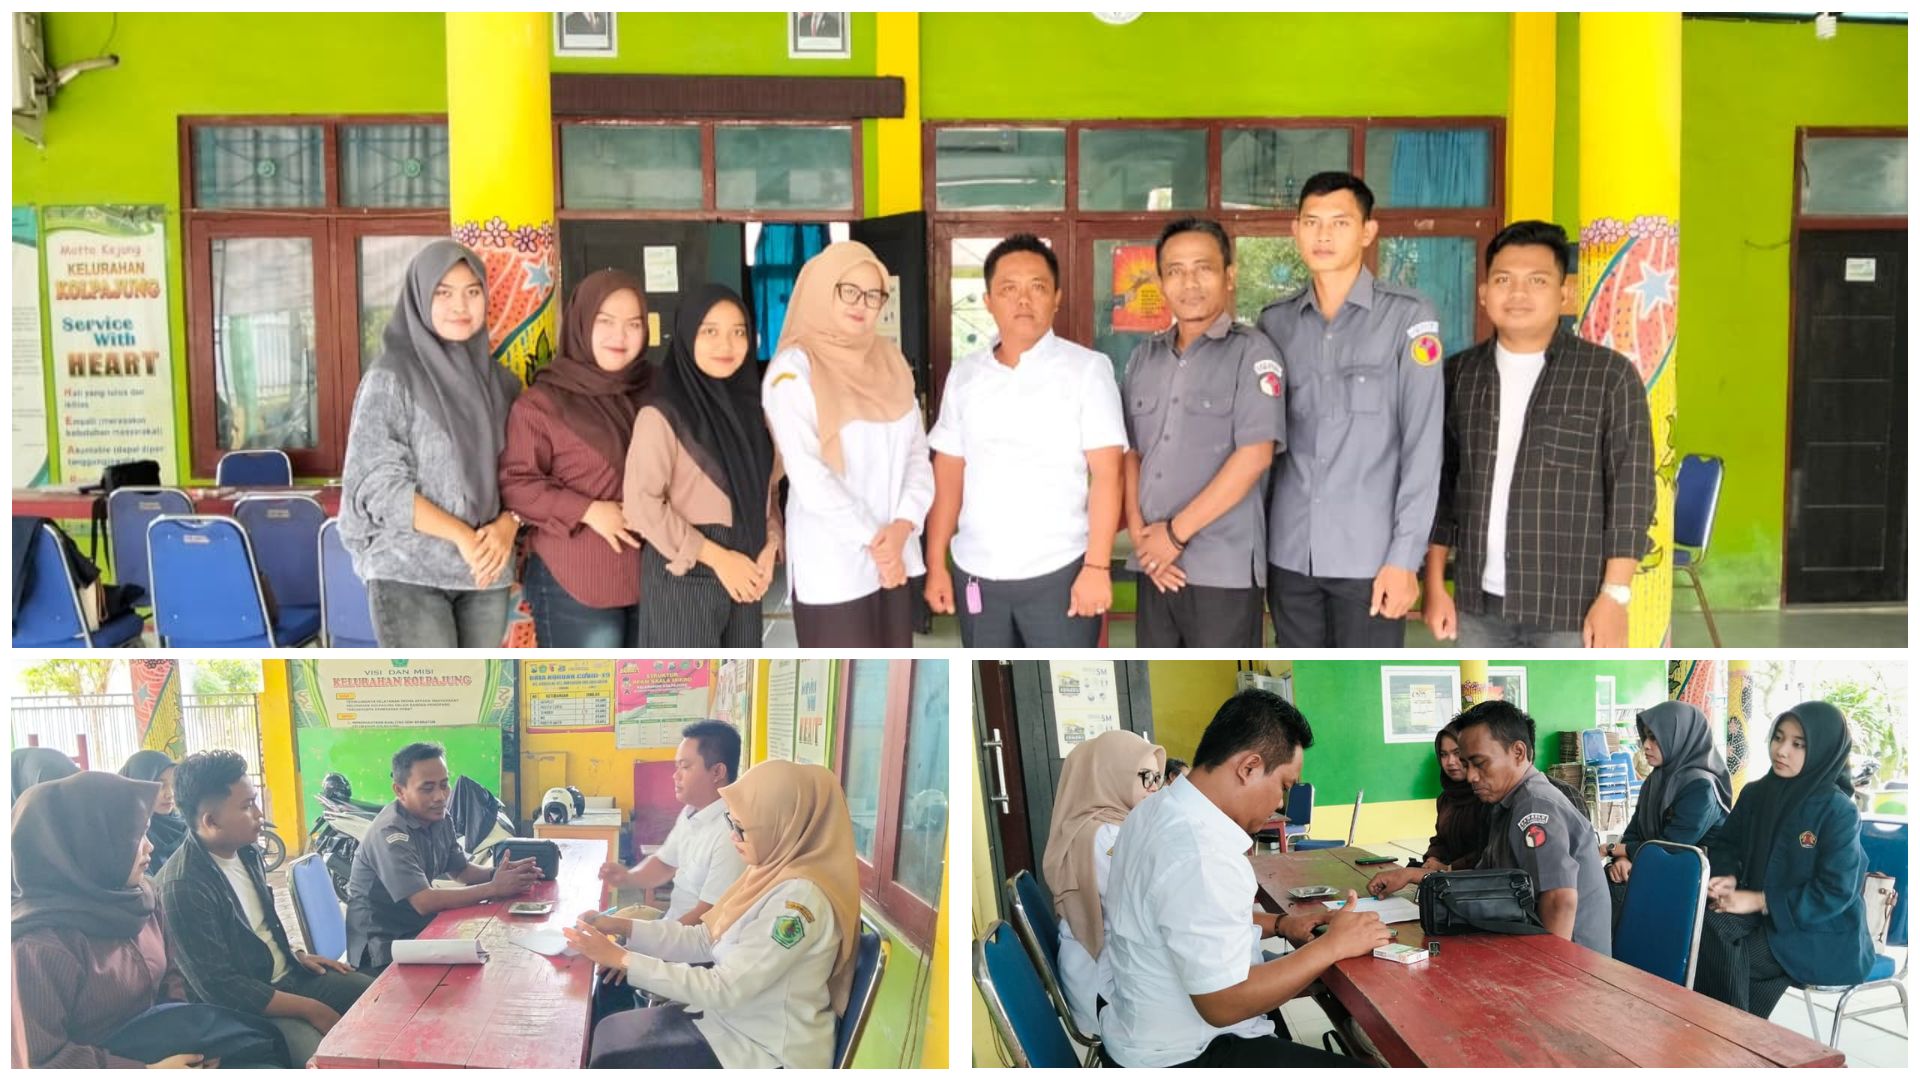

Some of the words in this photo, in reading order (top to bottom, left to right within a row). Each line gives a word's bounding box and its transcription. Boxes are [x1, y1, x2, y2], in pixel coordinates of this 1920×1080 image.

[67, 260, 145, 276] KELURAHAN
[55, 278, 160, 301] KOLPAJUNG
[62, 316, 134, 332] Service
[93, 331, 136, 346] With
[67, 350, 160, 378] HEART
[333, 677, 401, 688] KELURAHAN
[403, 675, 473, 687] KOLPAJUNG
